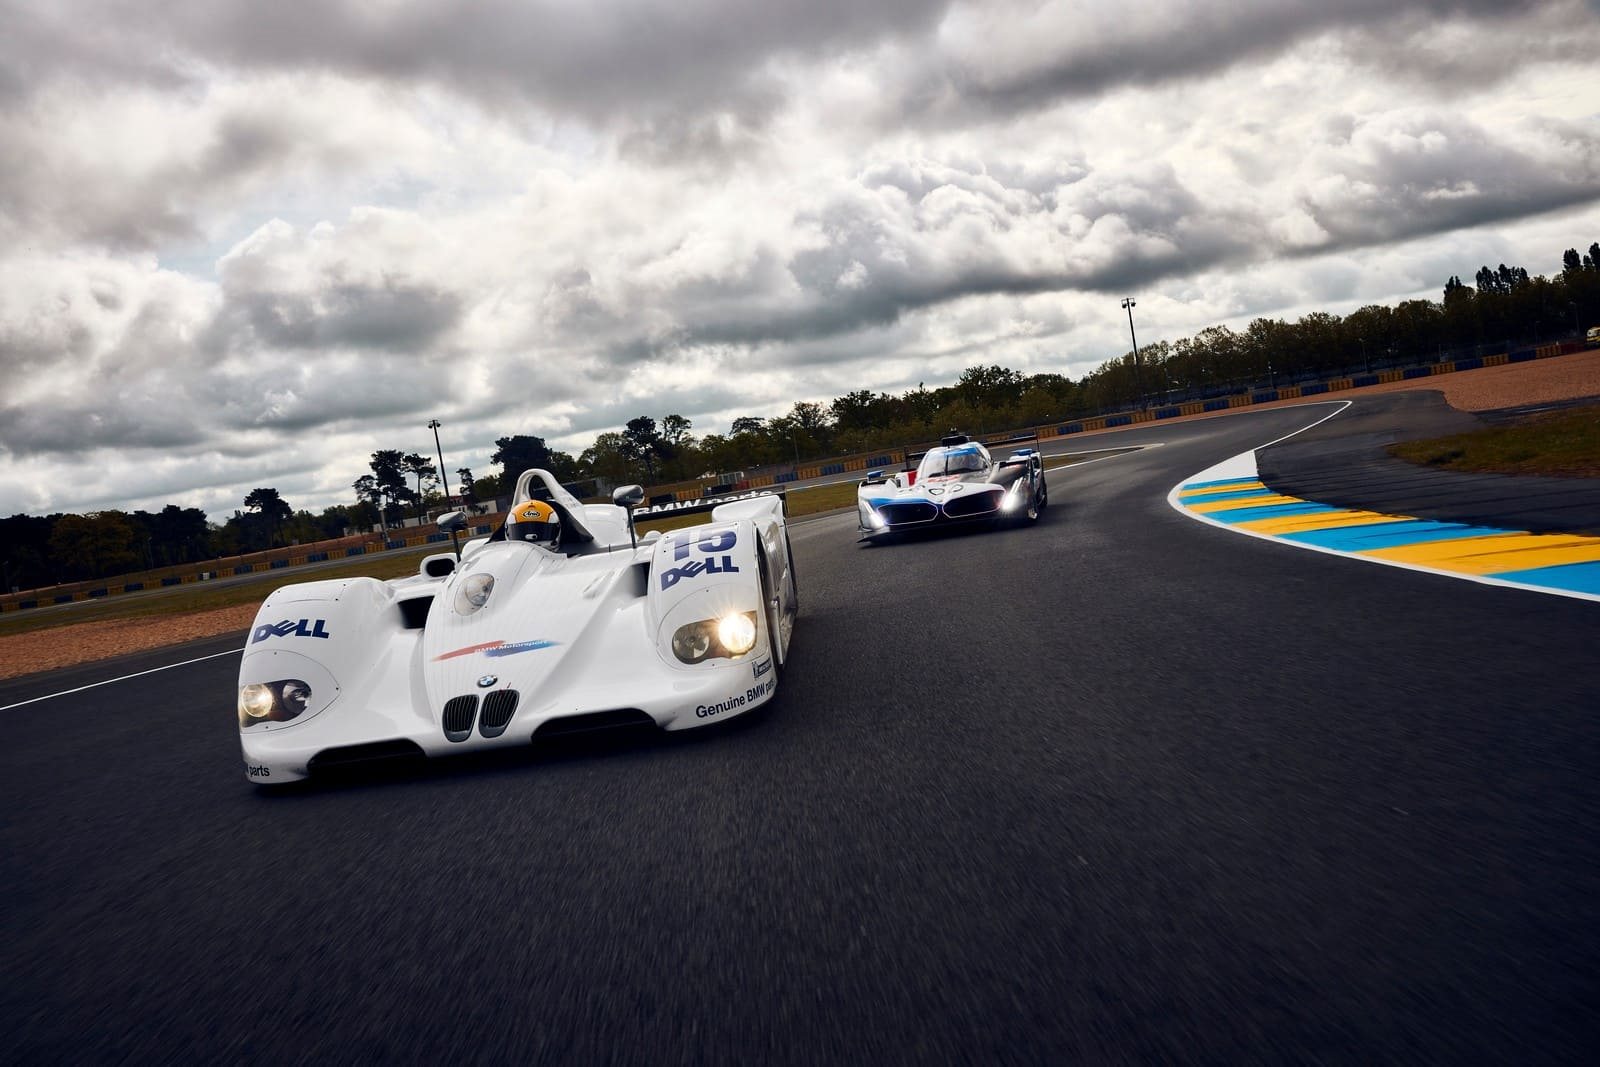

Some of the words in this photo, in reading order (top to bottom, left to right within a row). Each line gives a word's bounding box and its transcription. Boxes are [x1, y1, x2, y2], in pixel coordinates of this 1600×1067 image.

[633, 498, 701, 515] BMW
[673, 530, 737, 561] 15
[660, 555, 739, 591] DELL
[251, 619, 329, 644] DELL
[696, 697, 745, 718] Genuine
[746, 682, 765, 702] BMW
[248, 764, 270, 778] parts
